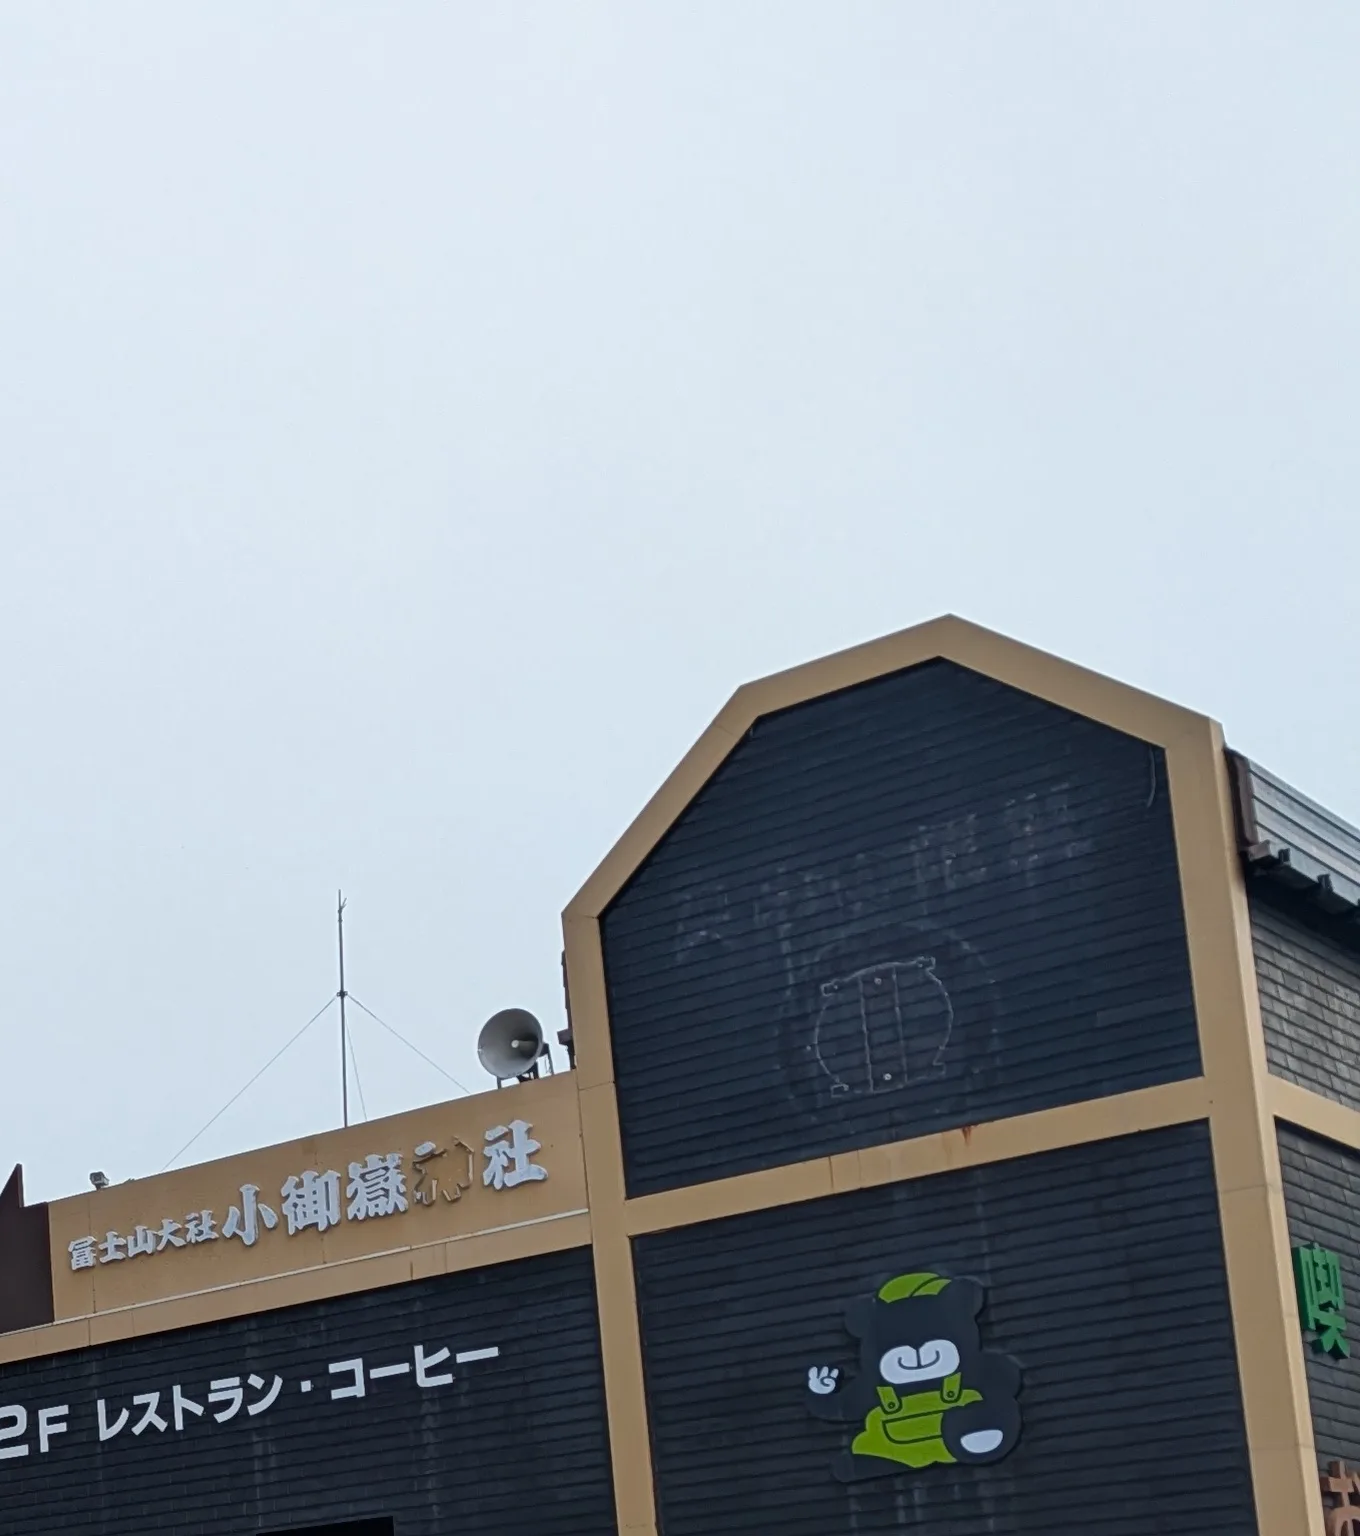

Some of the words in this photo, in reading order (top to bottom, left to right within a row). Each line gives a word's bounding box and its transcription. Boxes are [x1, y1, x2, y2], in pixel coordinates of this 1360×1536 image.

[222, 1119, 548, 1247] 小御嶽社
[97, 1345, 499, 1442] レストラン・コーヒー
